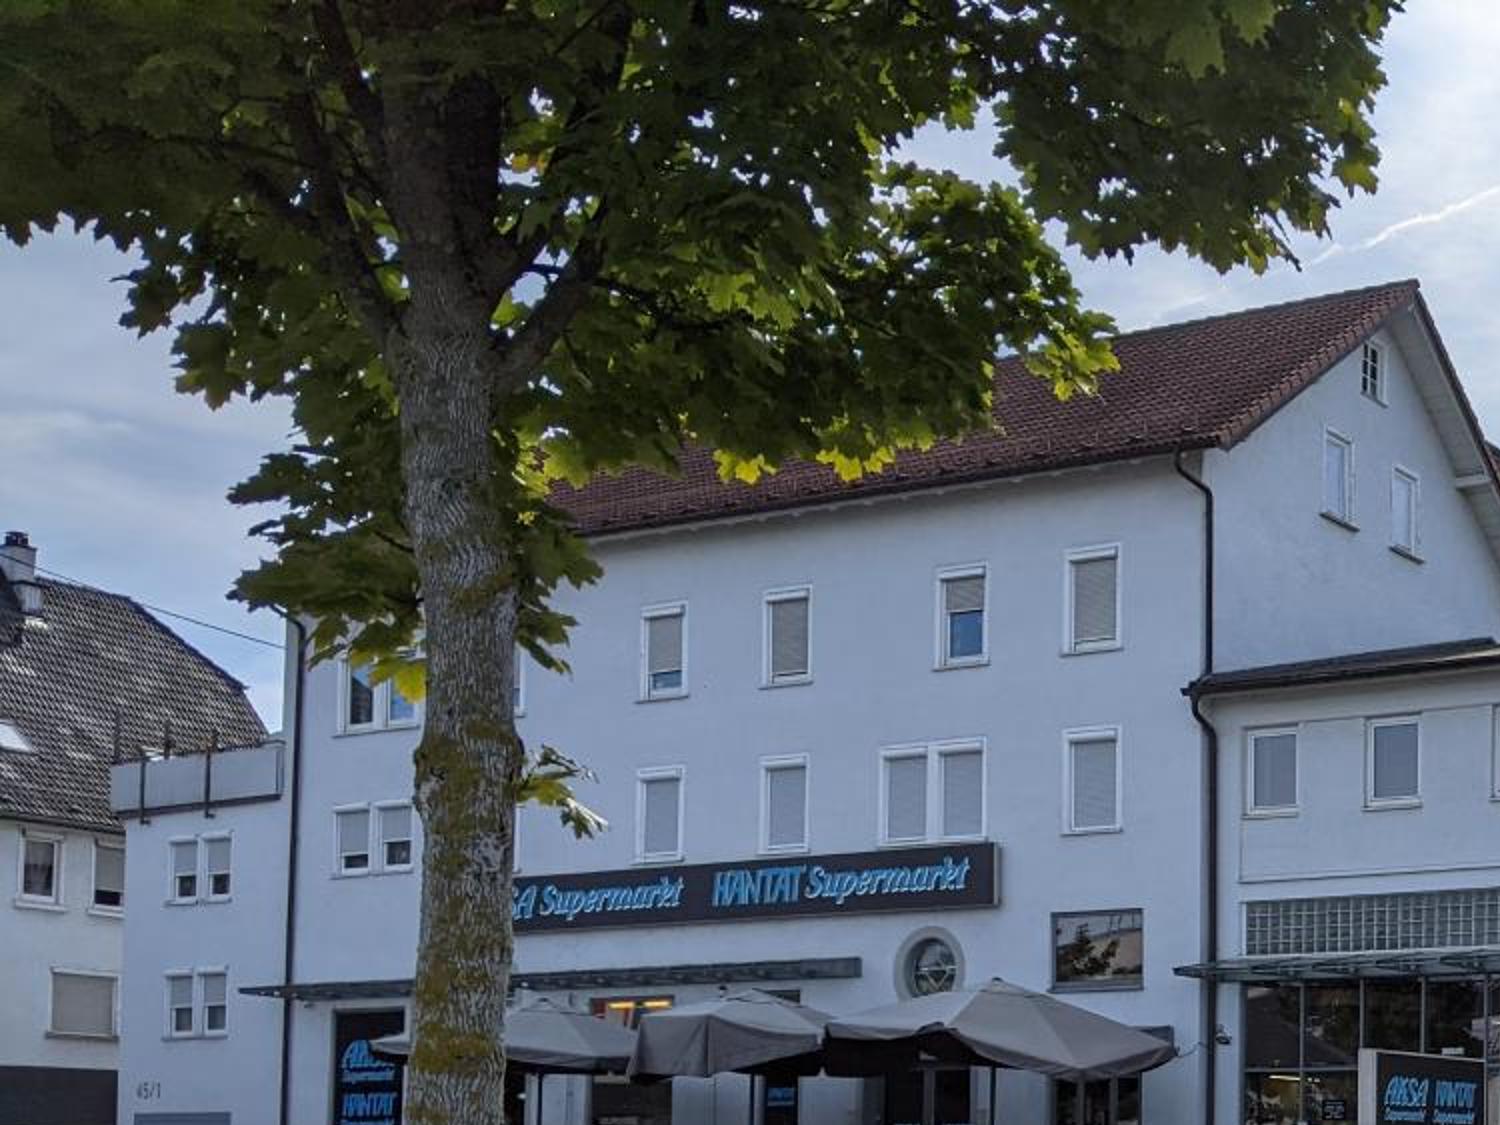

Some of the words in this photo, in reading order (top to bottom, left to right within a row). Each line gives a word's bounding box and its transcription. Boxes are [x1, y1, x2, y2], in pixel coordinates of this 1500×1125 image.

[539, 875, 685, 921] Supermarkt
[712, 865, 807, 907] HANTAT
[803, 855, 971, 905] Supermarkt
[1385, 1076, 1429, 1106] AKSA
